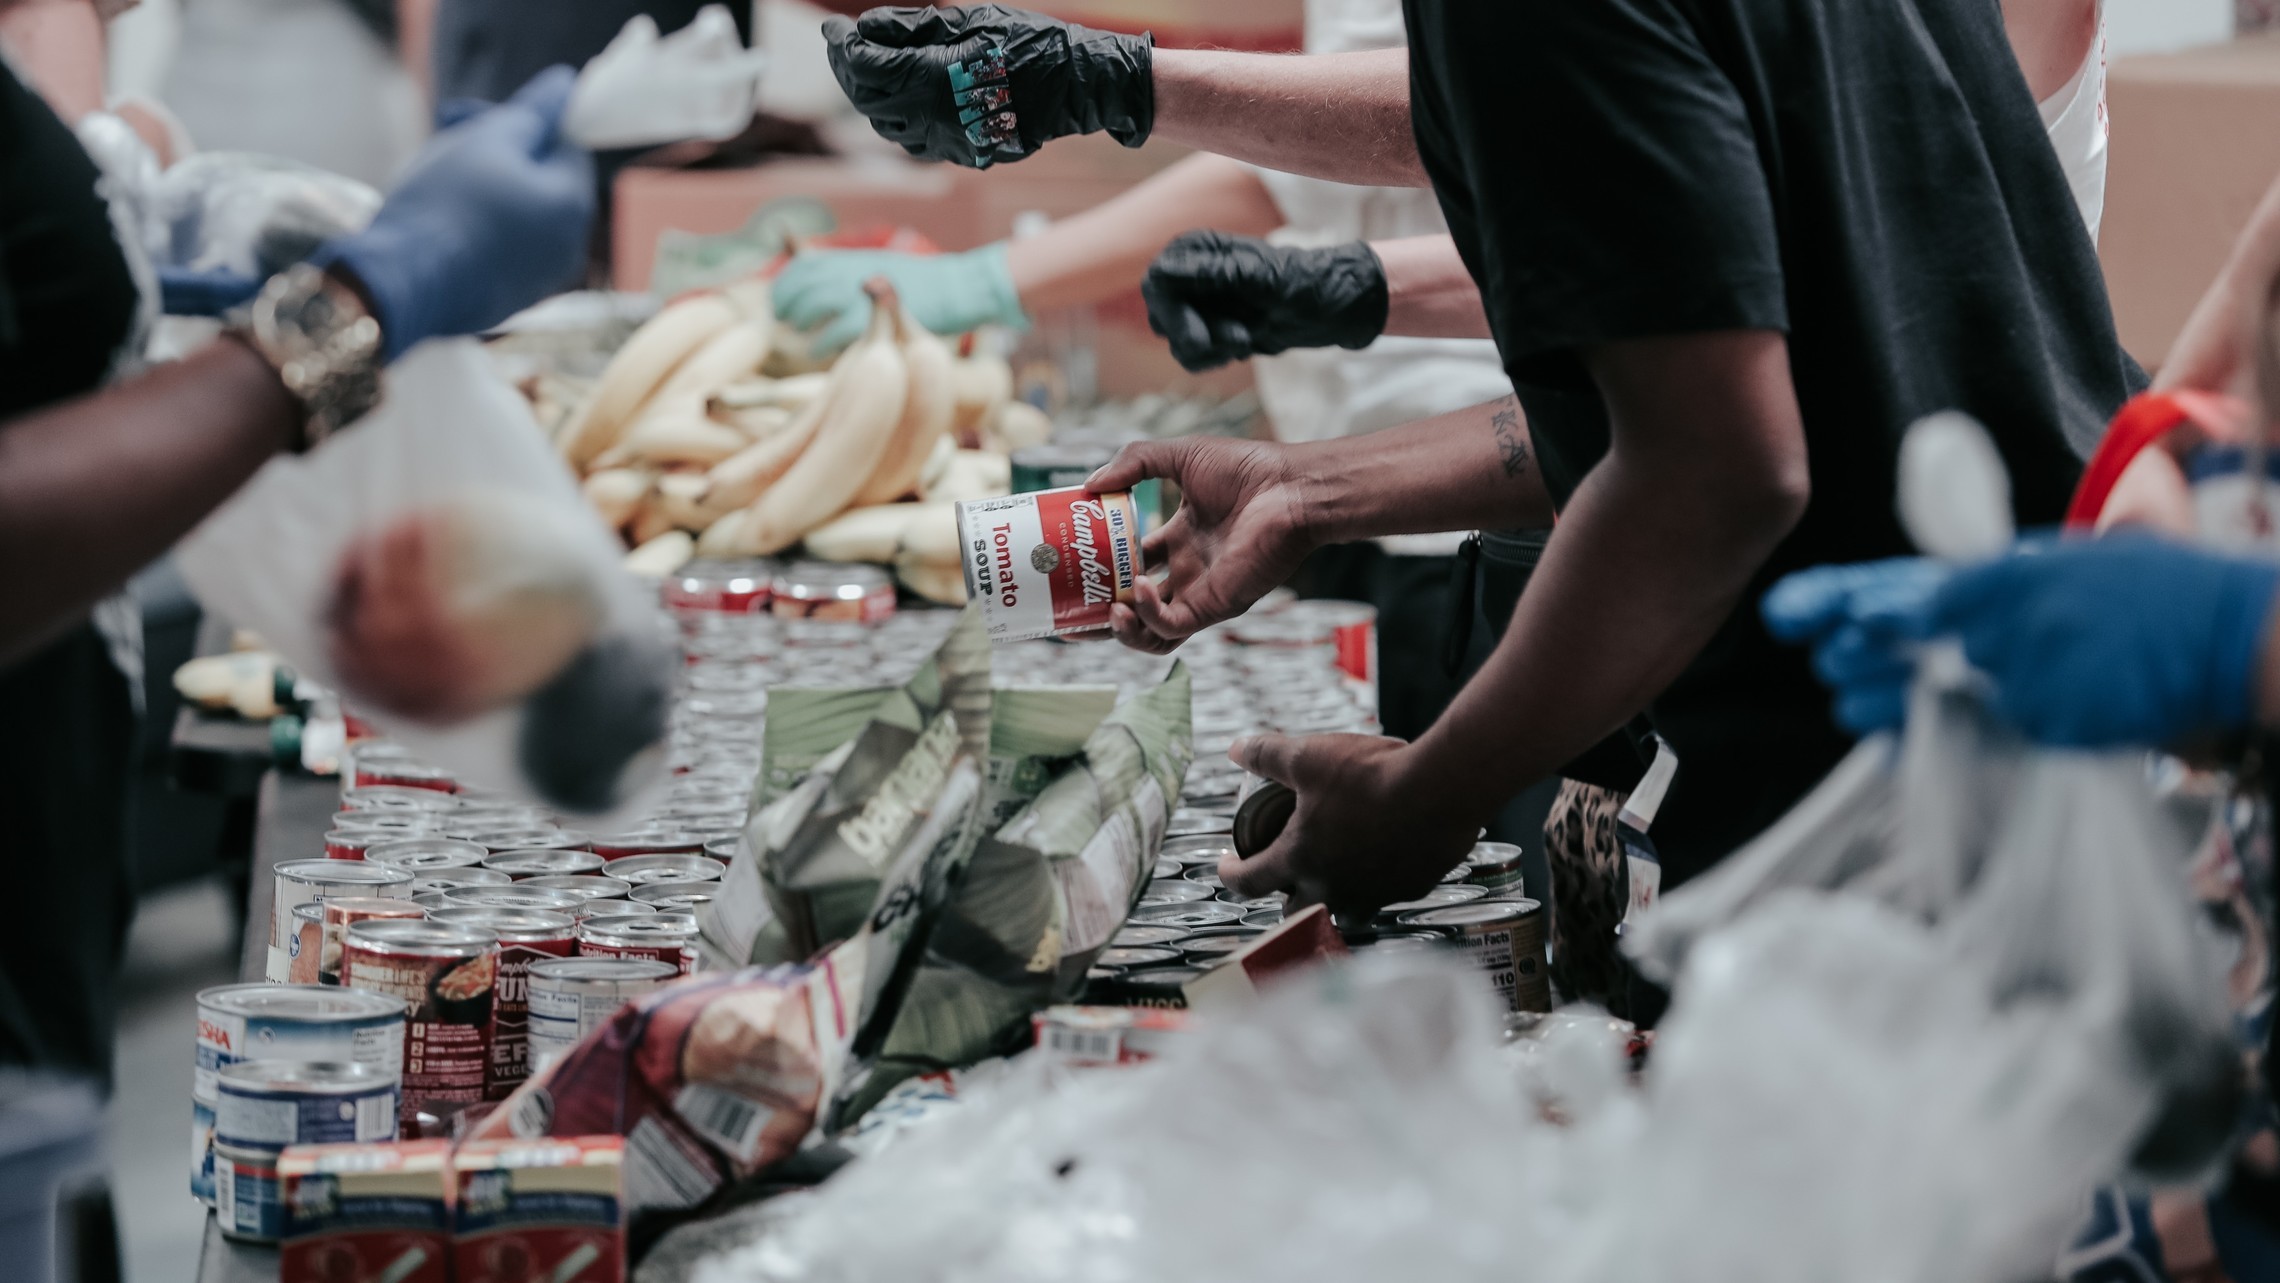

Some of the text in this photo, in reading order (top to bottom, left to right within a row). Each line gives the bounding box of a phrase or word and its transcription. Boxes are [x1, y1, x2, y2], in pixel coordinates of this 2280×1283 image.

[973, 538, 992, 595] SOUP
[993, 522, 1019, 608] Tomato
[1058, 522, 1075, 588] CONDENSED
[1069, 499, 1113, 606] Campbell's
[1115, 537, 1132, 590] BIGGER
[620, 951, 657, 961] Facts
[1484, 932, 1509, 945] Facts
[1492, 972, 1514, 986] 110
